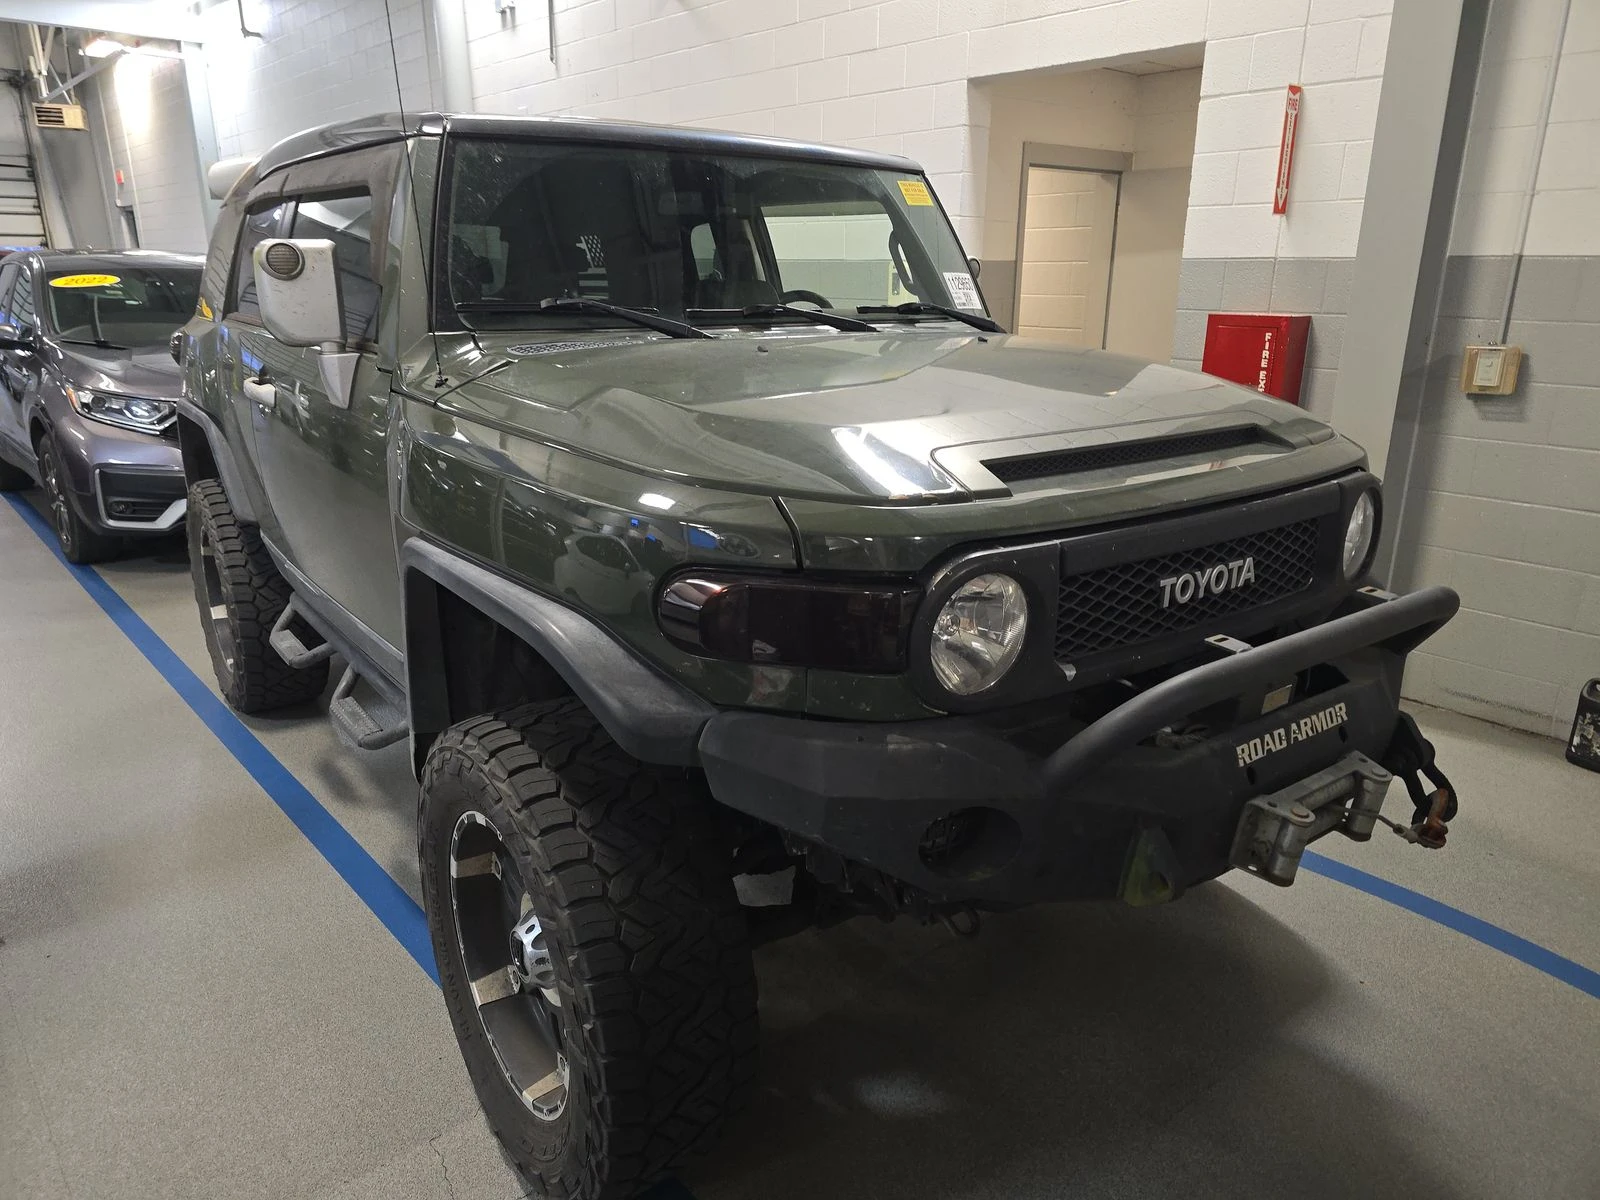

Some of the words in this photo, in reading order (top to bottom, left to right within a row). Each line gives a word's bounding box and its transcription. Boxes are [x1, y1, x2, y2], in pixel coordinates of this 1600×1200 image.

[64, 276, 108, 286] 2022
[1260, 332, 1272, 368] FIRE
[1160, 556, 1255, 609] TOYOTA
[1235, 727, 1287, 768] ROAD
[1290, 702, 1348, 744] ARMOR
